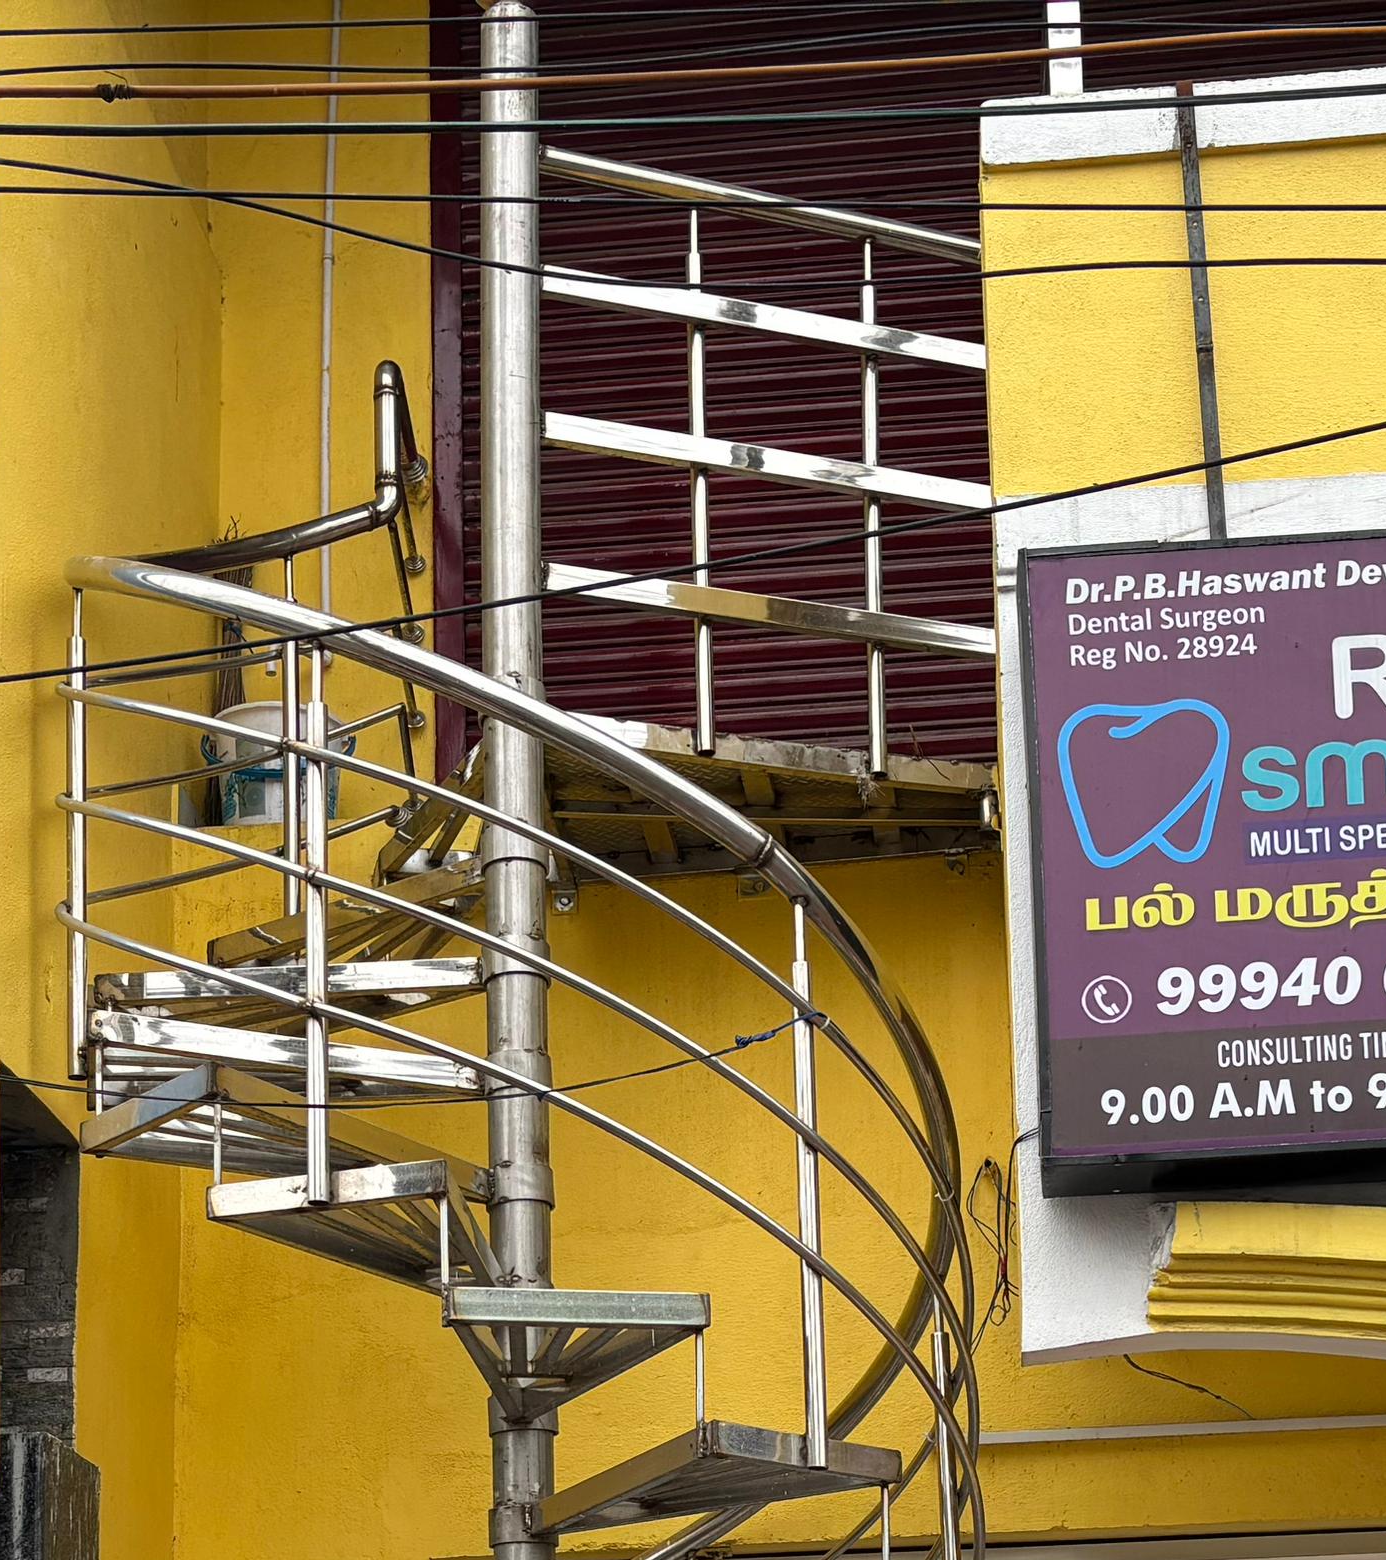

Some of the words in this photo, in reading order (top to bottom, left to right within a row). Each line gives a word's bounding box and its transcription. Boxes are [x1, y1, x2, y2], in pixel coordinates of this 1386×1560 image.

[1065, 562, 1326, 604] Dr.P.B.Haswant
[1068, 608, 1152, 635] Dental
[1160, 605, 1265, 631] Surgeon
[1070, 644, 1116, 669] Reg
[1125, 640, 1168, 663] No.
[1177, 633, 1257, 660] 28924
[1250, 829, 1331, 858] MULTI
[1084, 882, 1196, 931] பல்
[1156, 957, 1361, 1015] 99940
[1217, 1034, 1353, 1067] CONSULTING
[1100, 1085, 1195, 1126] 9.00
[1209, 1078, 1296, 1119] A.M
[1310, 1077, 1353, 1113] to
